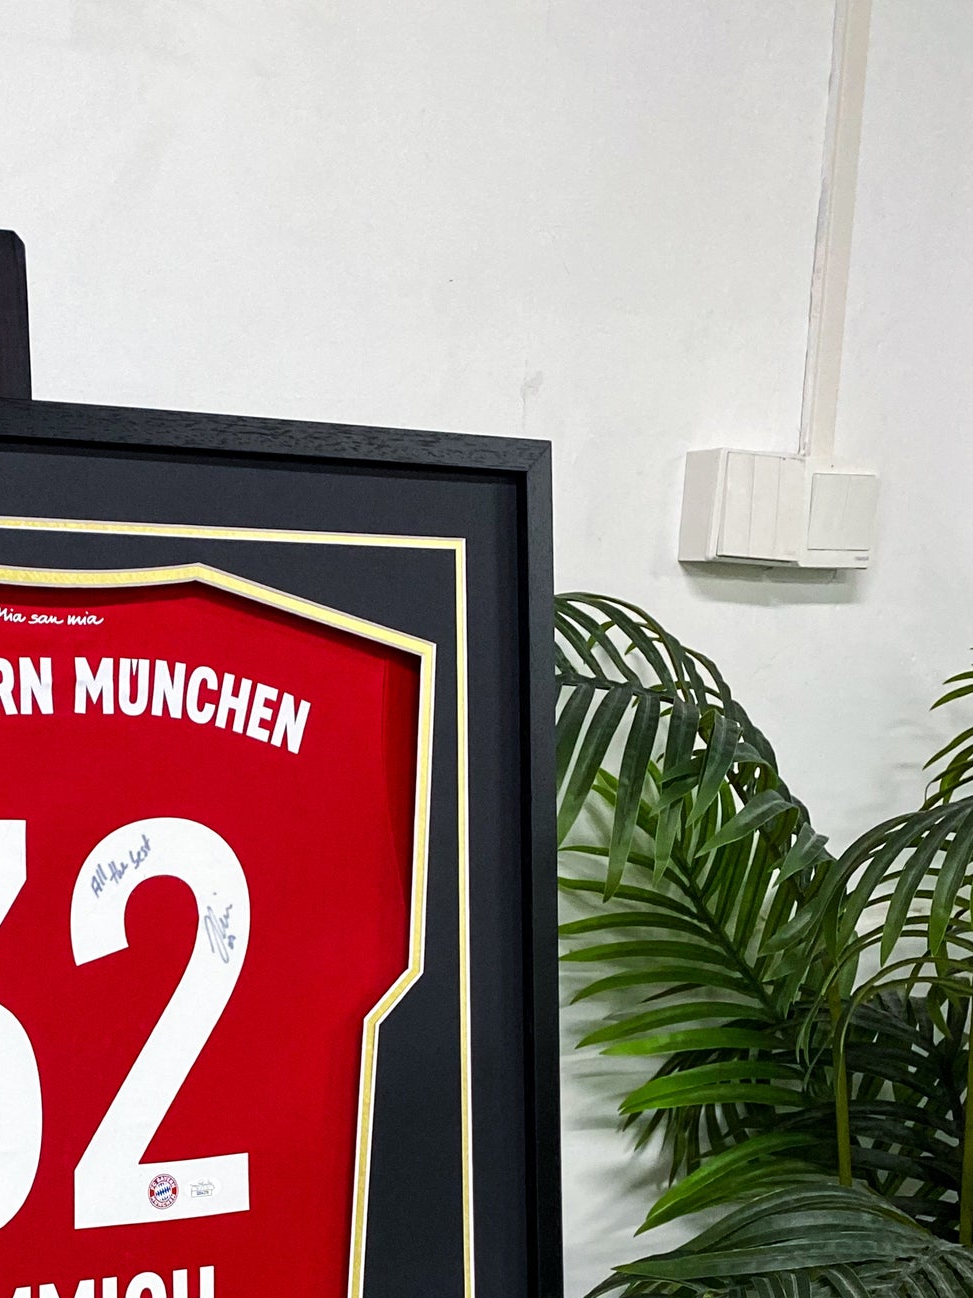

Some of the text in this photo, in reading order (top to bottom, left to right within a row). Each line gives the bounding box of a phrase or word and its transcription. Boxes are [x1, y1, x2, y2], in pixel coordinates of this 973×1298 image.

[28, 613, 64, 625] san
[67, 611, 104, 625] mia
[75, 656, 311, 754] MÜNCHEN
[90, 863, 108, 898] All
